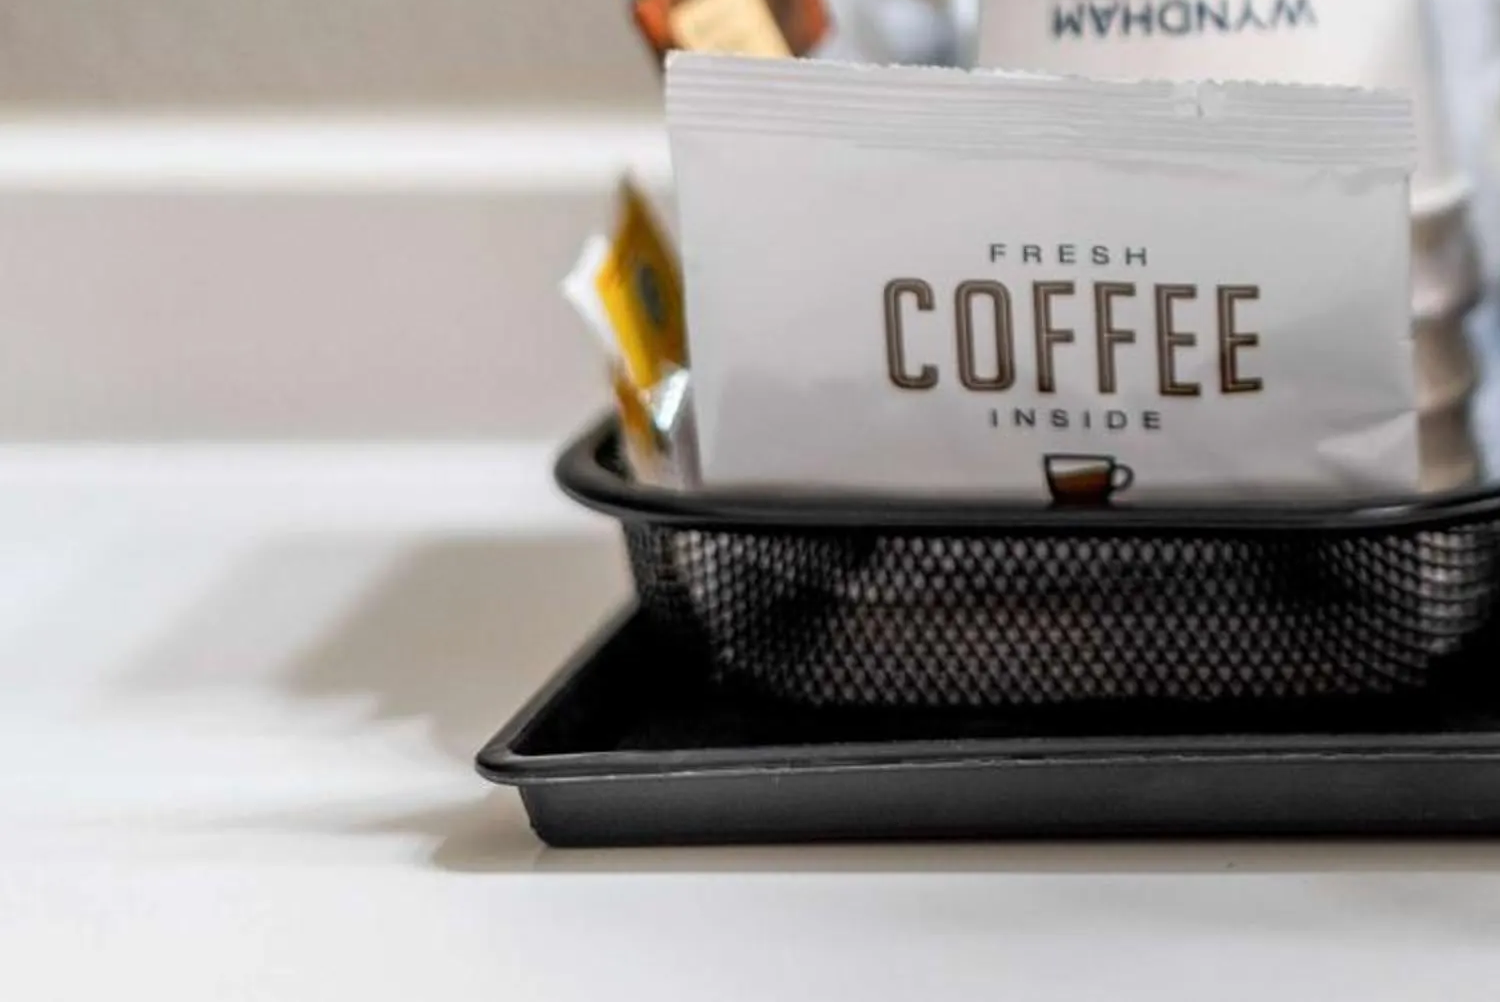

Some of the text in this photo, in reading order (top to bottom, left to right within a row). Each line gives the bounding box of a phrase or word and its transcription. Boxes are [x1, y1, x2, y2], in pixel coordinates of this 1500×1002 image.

[989, 244, 1149, 266] FRESH
[883, 277, 1264, 397] COFFEE
[990, 409, 1163, 430] INSIDE
